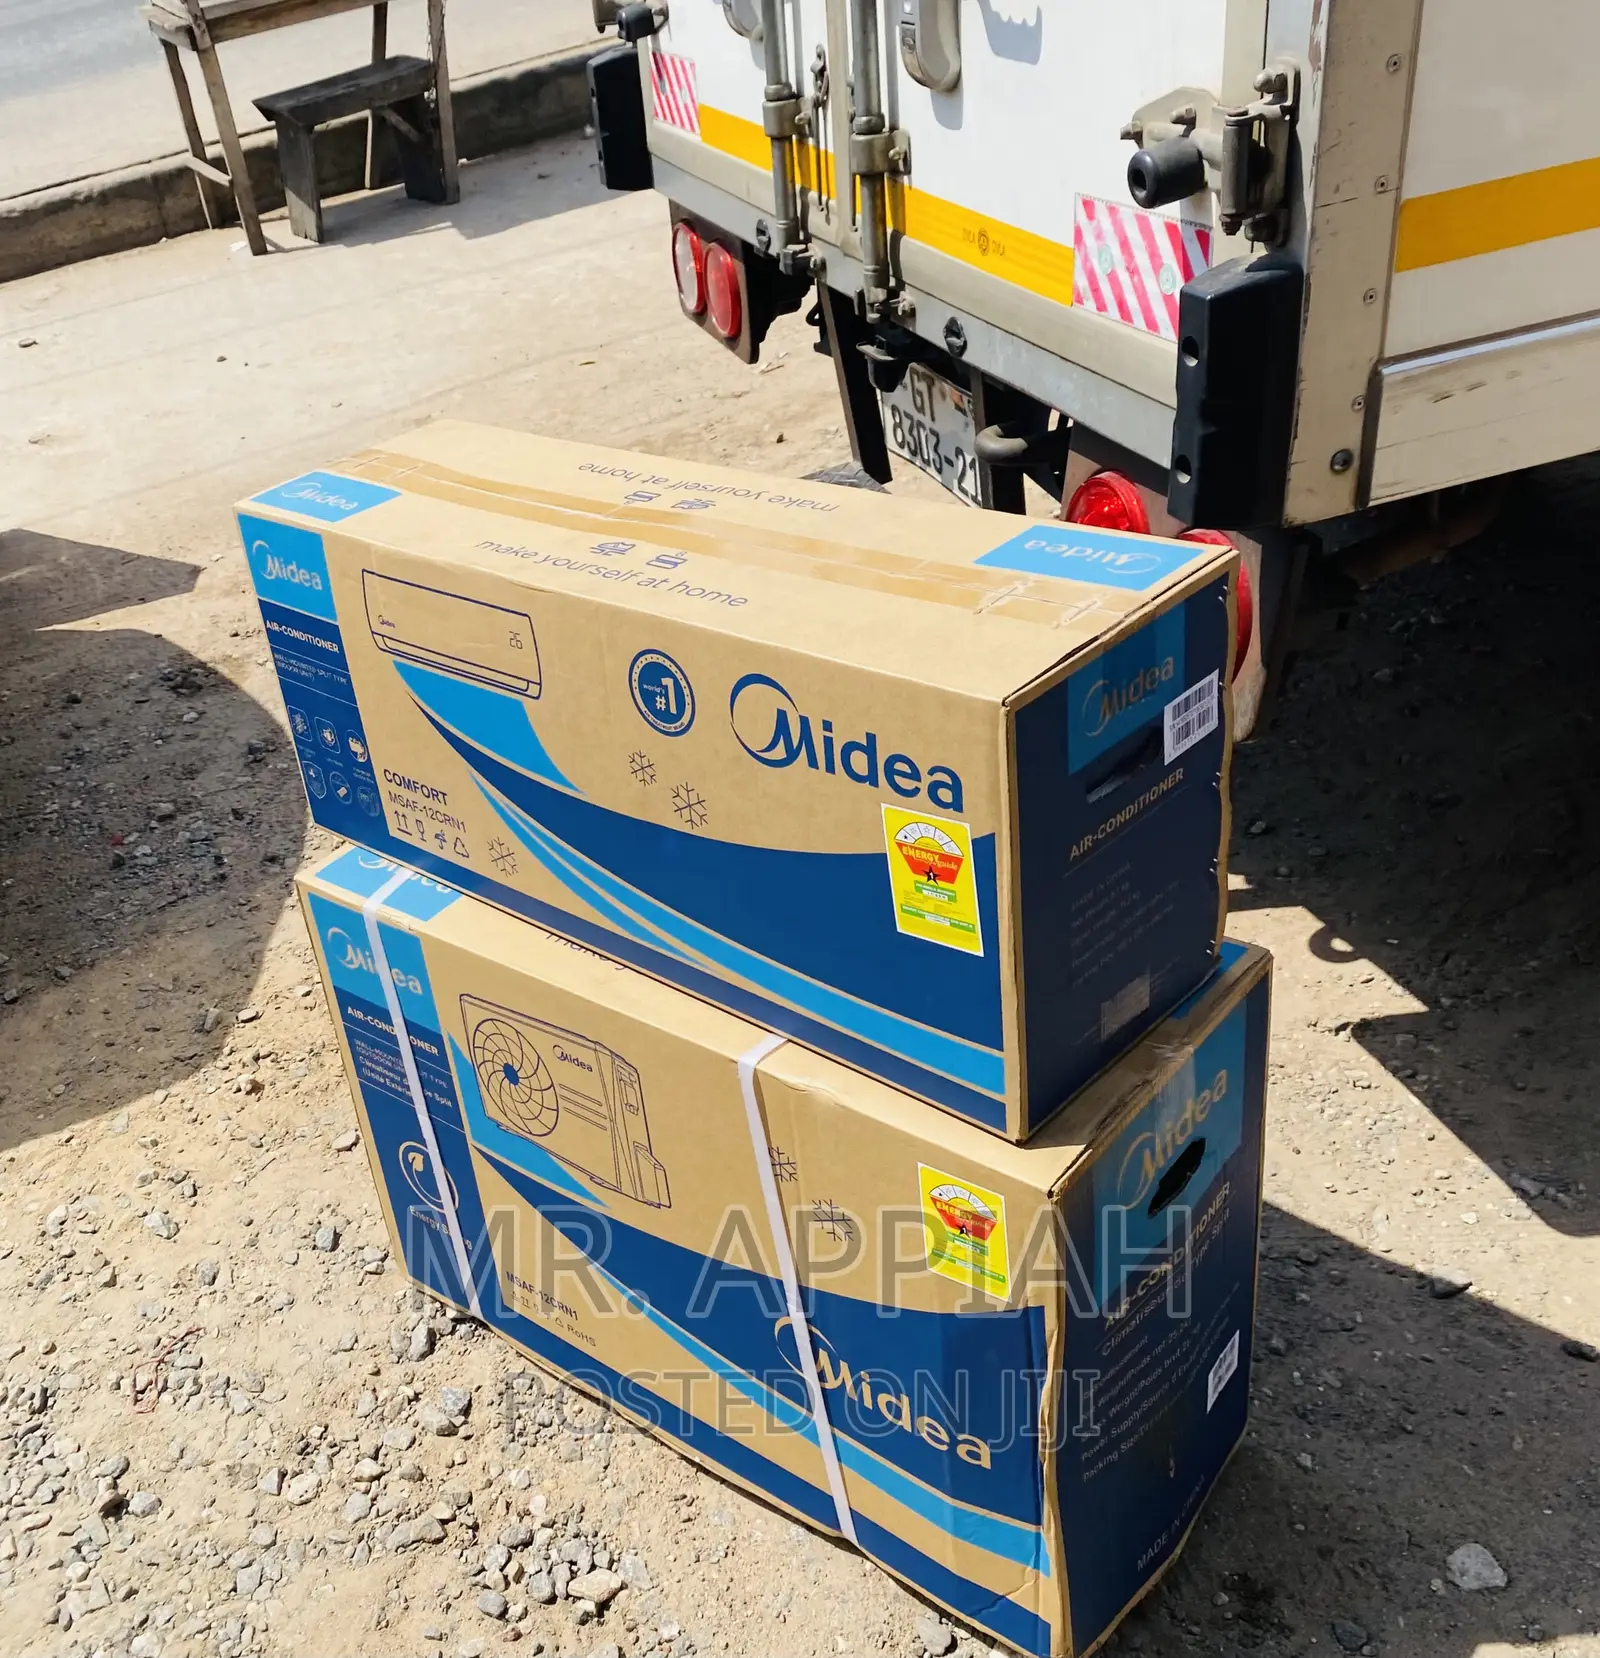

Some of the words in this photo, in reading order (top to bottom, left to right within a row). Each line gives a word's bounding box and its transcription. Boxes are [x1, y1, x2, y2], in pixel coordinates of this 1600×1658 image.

[909, 366, 936, 423] GT
[578, 462, 638, 483] home
[890, 404, 982, 508] 8303-21
[281, 482, 359, 511] Midea
[646, 473, 669, 492] at
[668, 478, 769, 501] yourself
[768, 493, 840, 513] make
[252, 539, 323, 592] Midea
[474, 538, 538, 560] make
[536, 553, 642, 583] yourself
[637, 574, 668, 590] at
[668, 580, 748, 608] home
[1024, 538, 1162, 574] Midea
[265, 619, 340, 654] AIR-CONDITIONER
[508, 631, 523, 650] 26
[1082, 656, 1175, 738] Midea
[730, 673, 964, 814] Midea
[382, 768, 448, 806] COMFORT
[387, 789, 467, 834] MSAF-12CRN1
[1069, 767, 1185, 862] AIR-CONDITIONER
[901, 844, 941, 864] ENERGY
[928, 871, 934, 880] 1
[327, 926, 423, 996] Miea
[553, 1044, 594, 1073] Midea
[1117, 1069, 1228, 1210] Midea
[409, 1204, 440, 1231] Energy
[505, 1270, 579, 1321] MSAF-12CRN1
[566, 1323, 597, 1347] RoHS
[775, 1316, 992, 1470] Midea
[1137, 1529, 1169, 1573] MADE
